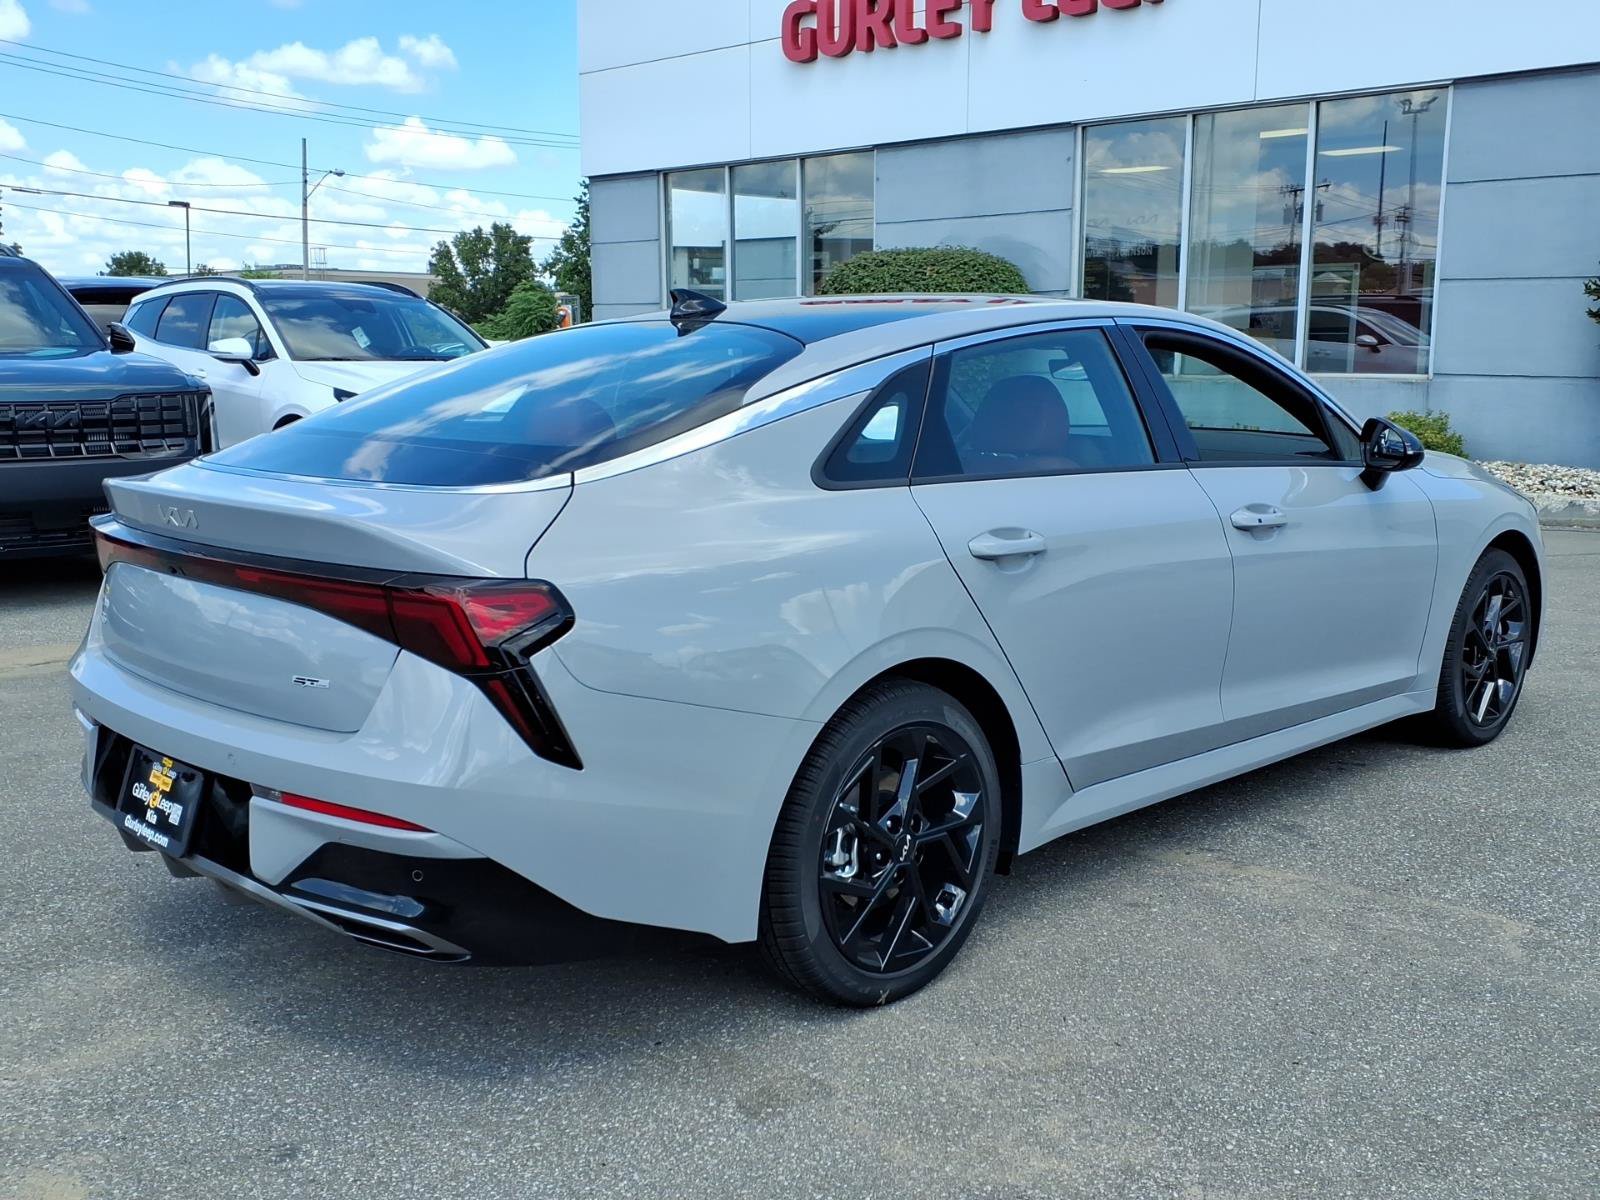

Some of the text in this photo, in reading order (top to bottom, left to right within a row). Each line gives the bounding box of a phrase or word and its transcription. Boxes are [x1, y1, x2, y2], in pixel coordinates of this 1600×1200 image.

[781, 0, 993, 64] GURLEY
[159, 503, 200, 530] KIA
[145, 808, 157, 825] Kia
